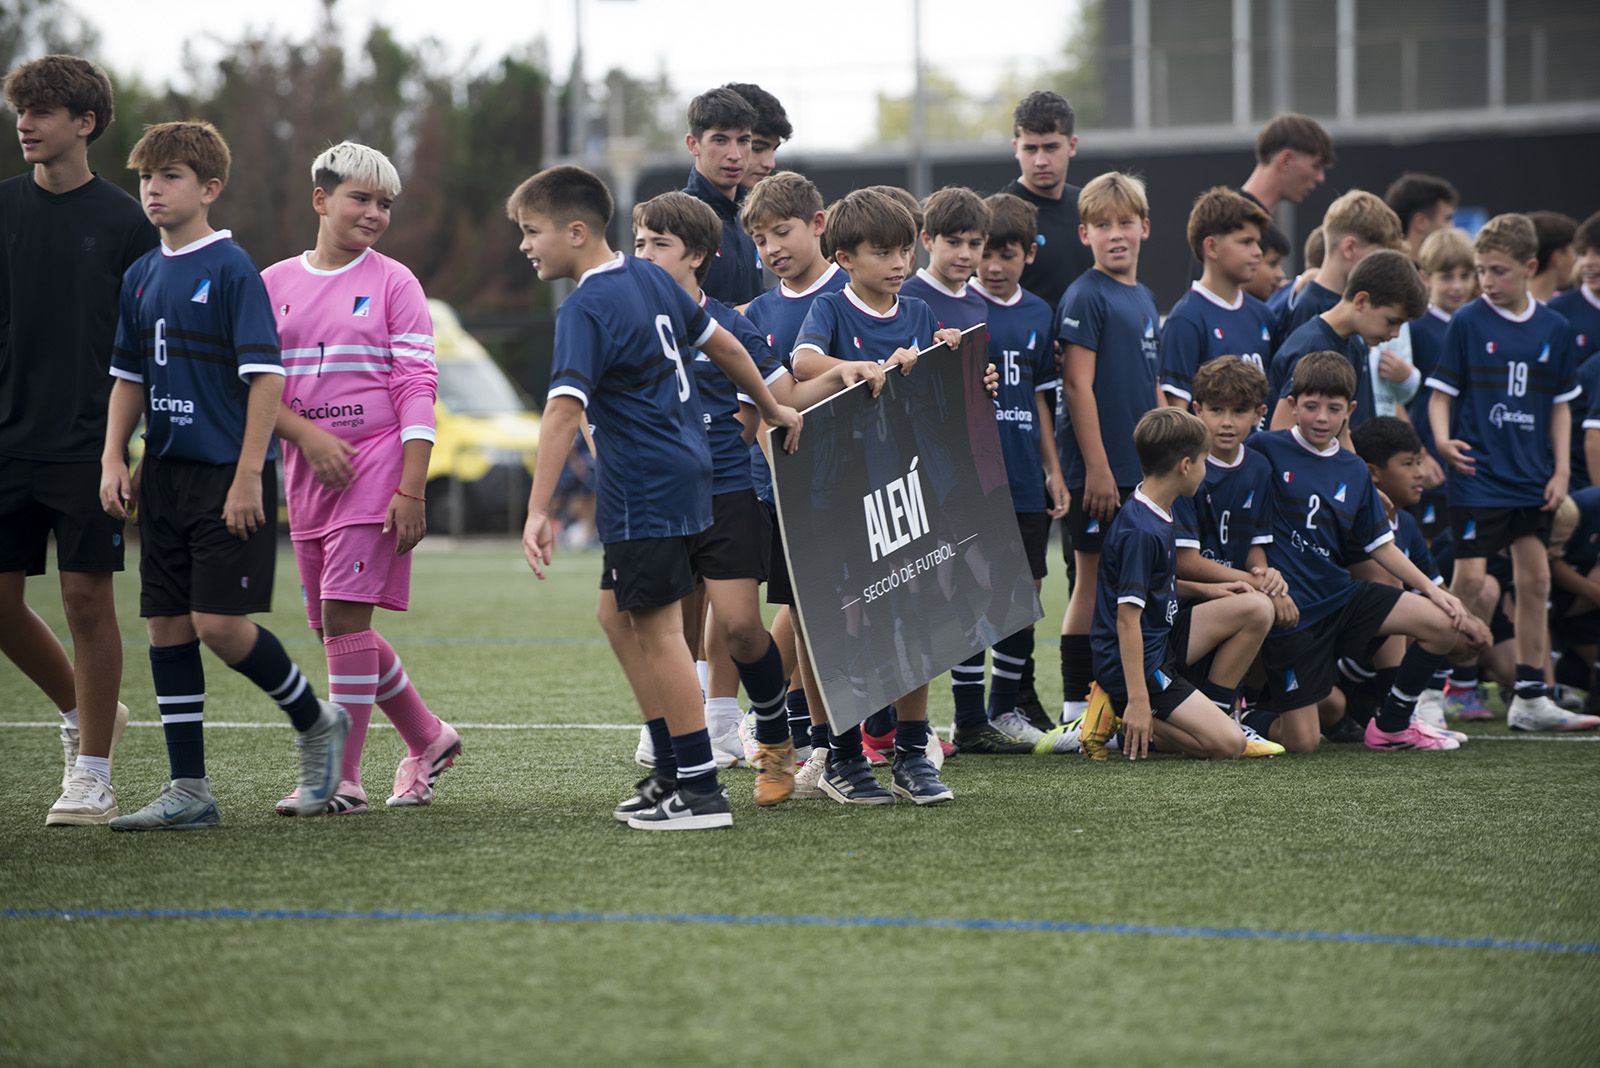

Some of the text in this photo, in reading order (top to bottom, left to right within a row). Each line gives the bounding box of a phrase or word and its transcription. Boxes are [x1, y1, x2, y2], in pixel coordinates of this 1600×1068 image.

[154, 317, 168, 367] 6
[317, 341, 325, 379] 1
[655, 314, 691, 403] 9
[1003, 350, 1021, 386] 15
[1507, 360, 1529, 398] 19
[300, 403, 364, 421] acciona
[863, 455, 931, 563] ALEVÍ
[1219, 509, 1231, 545] 6
[1306, 494, 1321, 530] 2
[863, 543, 957, 603] SECCIÓ DE FUTBOL
